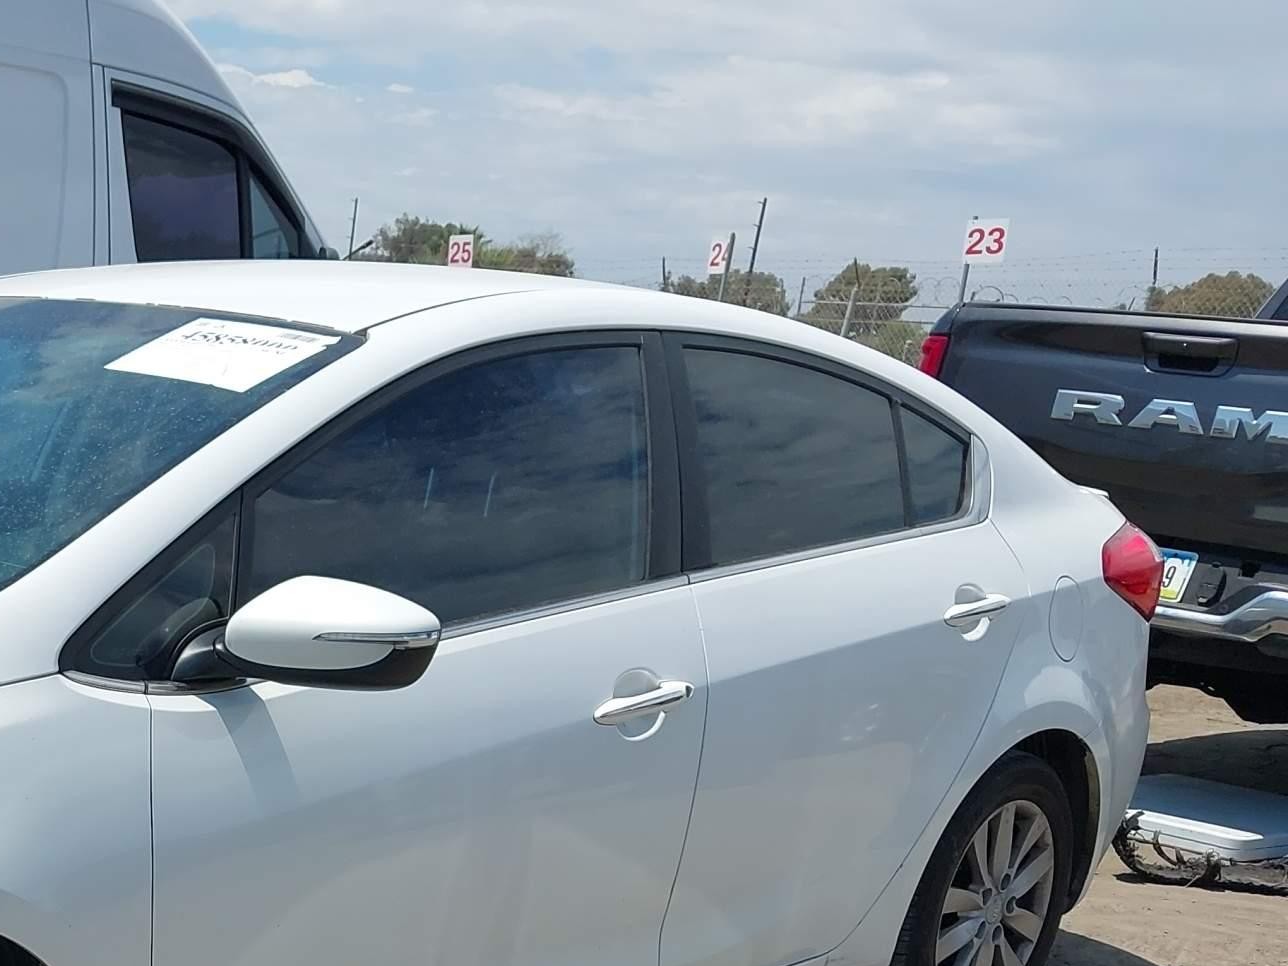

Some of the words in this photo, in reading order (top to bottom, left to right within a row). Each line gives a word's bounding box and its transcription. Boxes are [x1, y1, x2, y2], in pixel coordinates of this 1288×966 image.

[450, 241, 472, 264] 25
[965, 227, 1005, 255] 23
[1050, 389, 1288, 444] RAM
